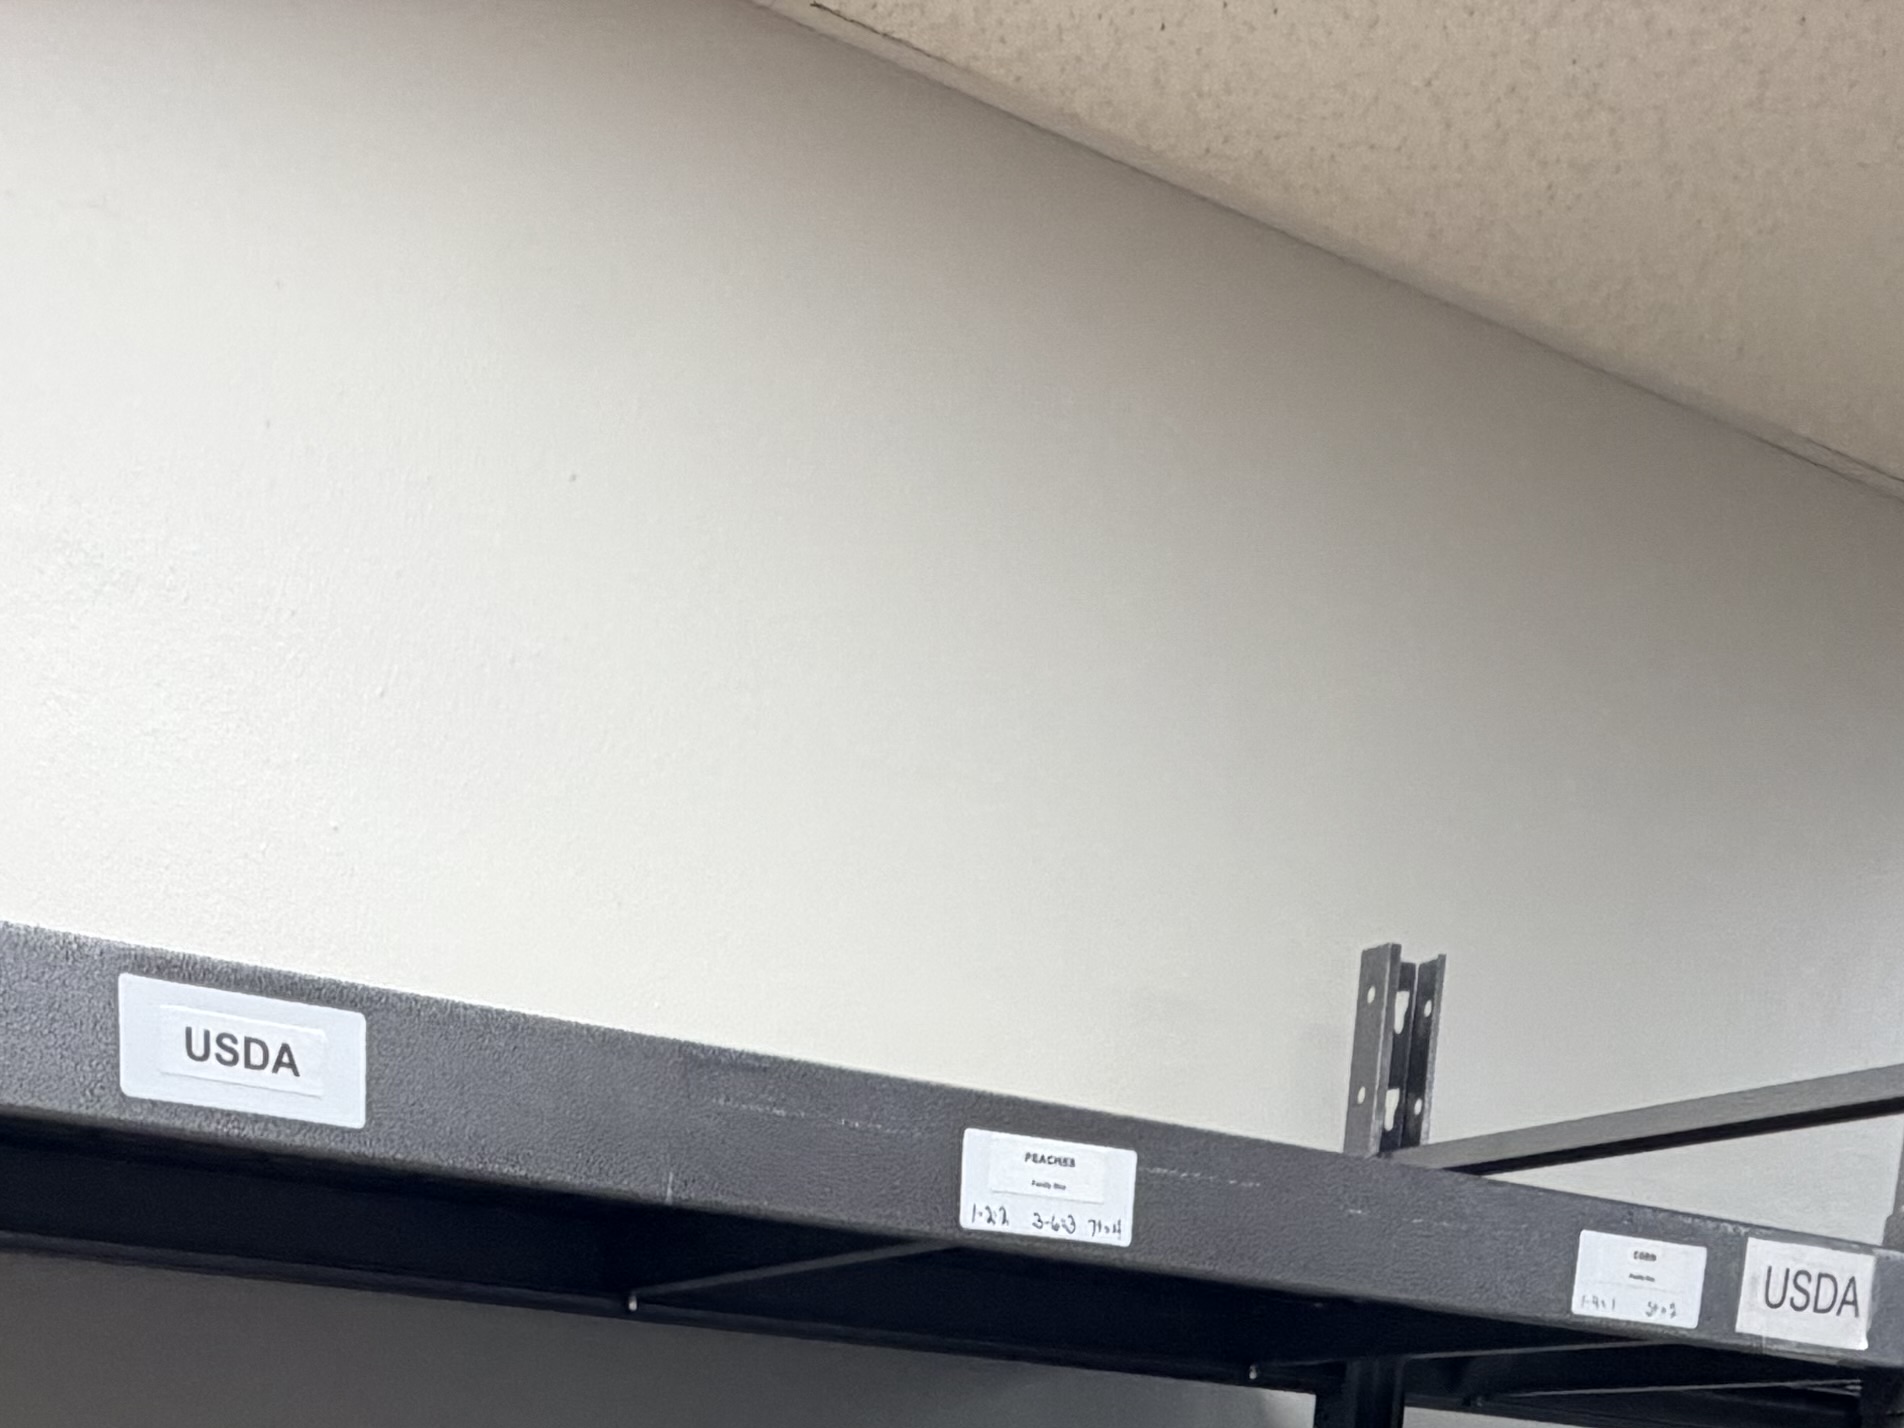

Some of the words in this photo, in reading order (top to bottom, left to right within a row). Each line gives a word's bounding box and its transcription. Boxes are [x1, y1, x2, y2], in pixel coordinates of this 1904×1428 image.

[184, 1026, 301, 1077] USDA
[1024, 1151, 1076, 1168] PEACHES
[1764, 1265, 1861, 1318] USDA
